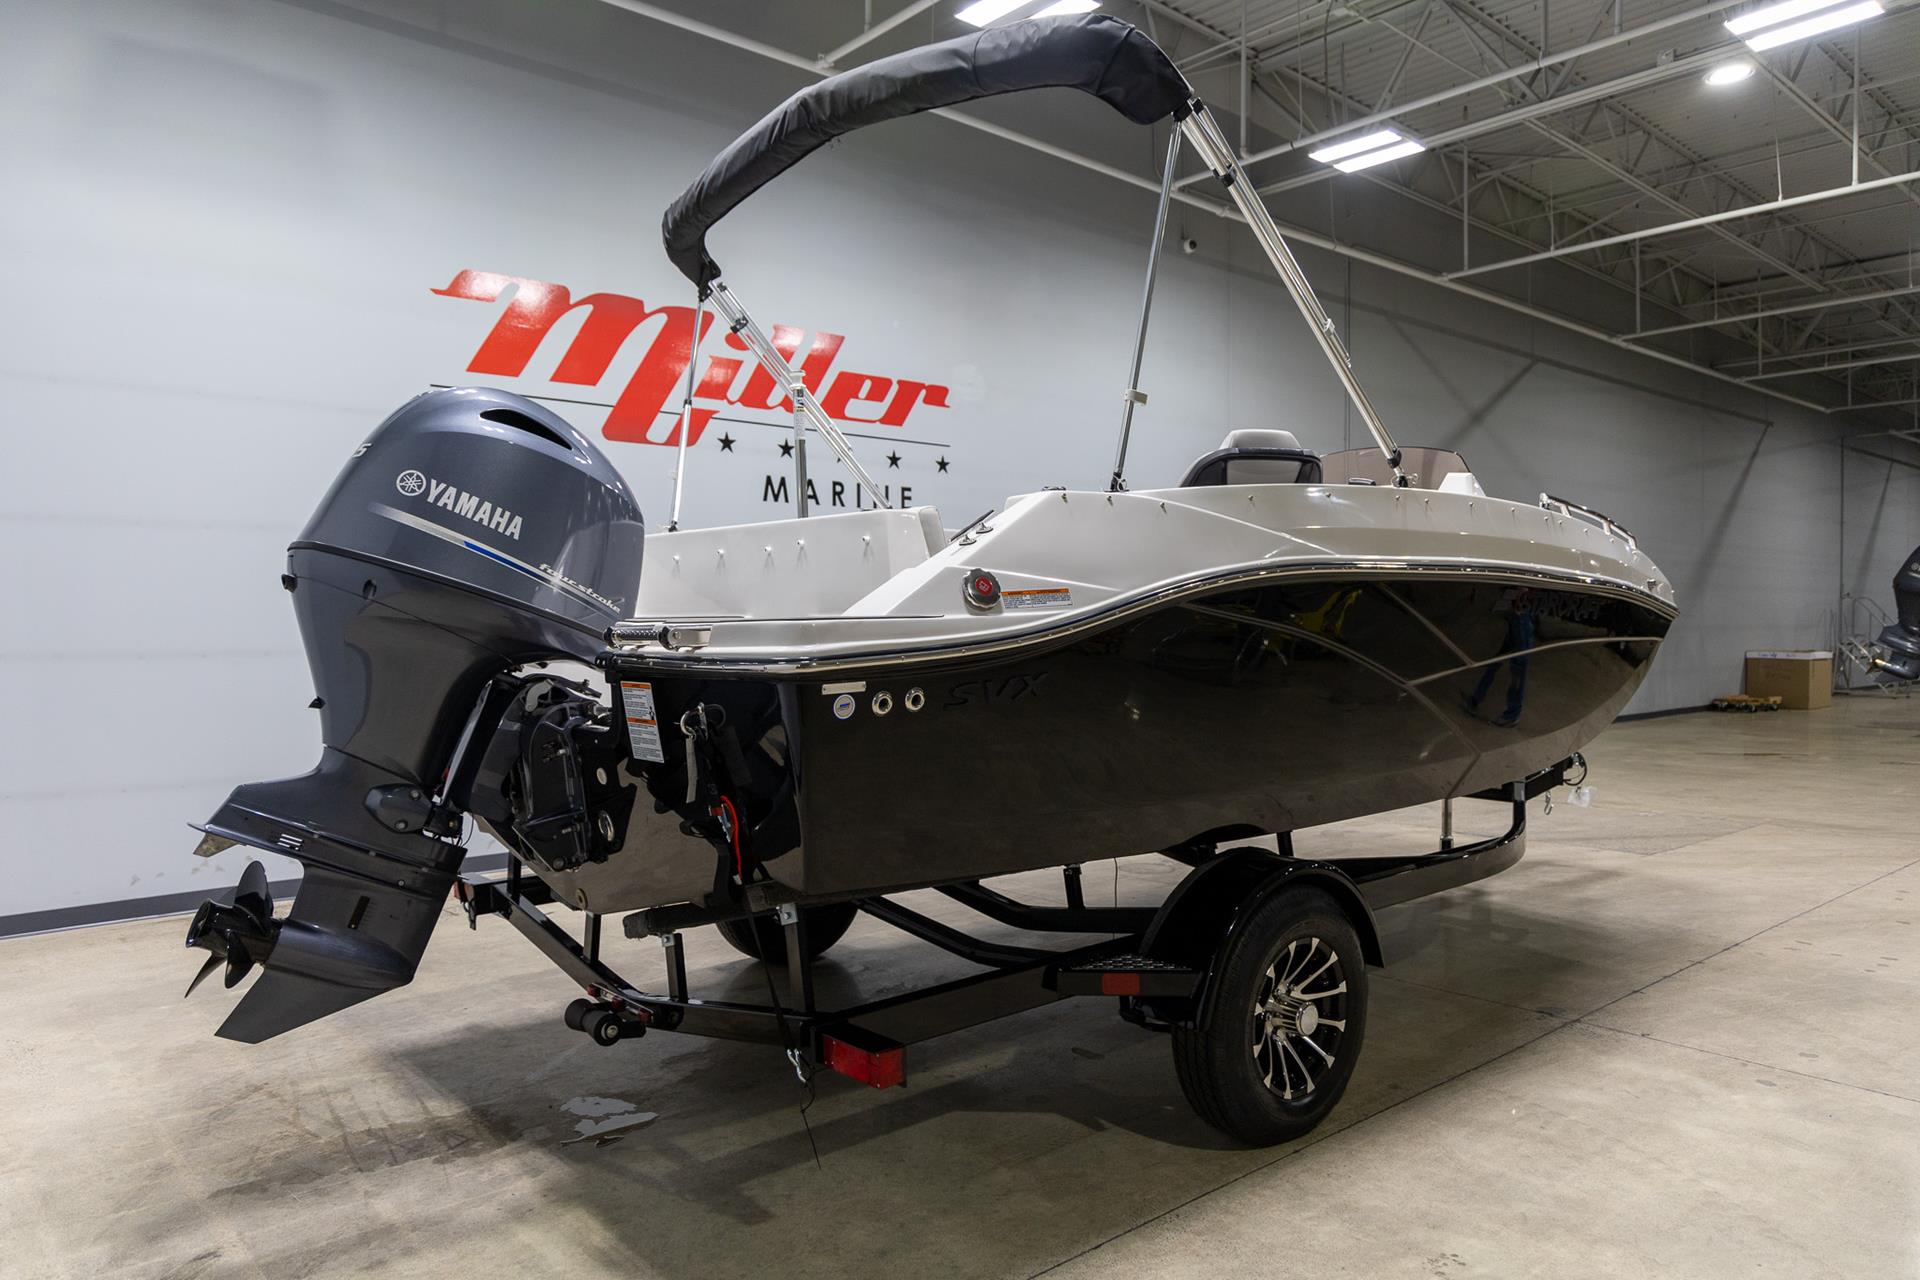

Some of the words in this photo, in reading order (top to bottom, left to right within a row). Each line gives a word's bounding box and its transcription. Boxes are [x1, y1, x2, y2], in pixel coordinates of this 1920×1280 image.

[430, 268, 950, 447] Miller
[427, 478, 523, 540] YAMAHA
[943, 671, 1049, 709] SVX
